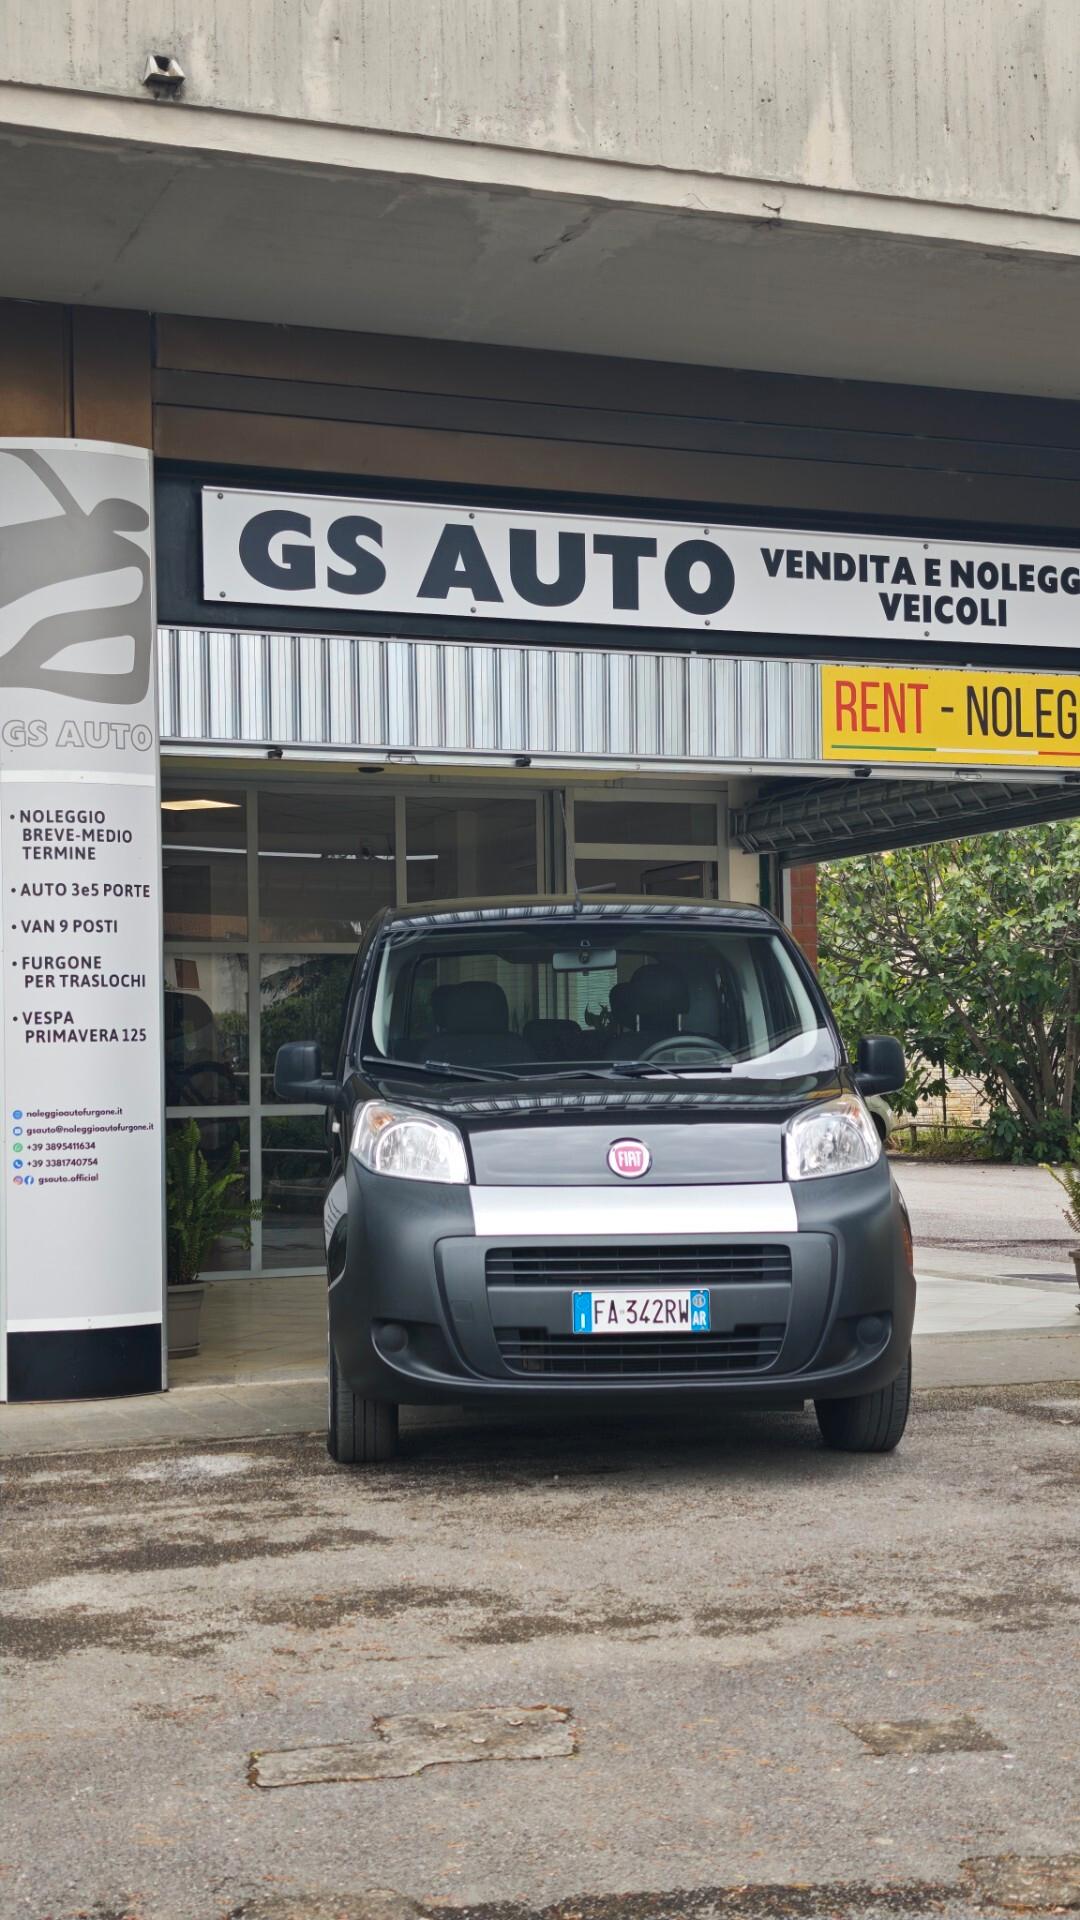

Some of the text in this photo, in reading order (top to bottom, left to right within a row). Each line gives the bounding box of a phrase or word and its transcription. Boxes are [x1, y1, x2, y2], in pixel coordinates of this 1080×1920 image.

[238, 509, 735, 615] GS AUTO
[760, 547, 1080, 595] VENDITA E NOLEGG
[878, 592, 1007, 627] VEICOLI
[835, 680, 928, 734] RENT
[967, 686, 1077, 740] NOLEG
[2, 719, 153, 752] GS AUTO
[20, 809, 106, 824] NOLEGGIO
[22, 828, 133, 844] BREVE-MEDIO
[22, 846, 96, 860] TERMINE
[20, 883, 151, 898] AUTO 3e5 PORTE
[21, 919, 118, 933] VAN 9 POSTI
[22, 956, 102, 970] FURGONE
[24, 974, 146, 988] PER TRASLOCHI
[22, 1011, 74, 1025] VESPA
[25, 1028, 147, 1043] PRIMAVERA 125
[26, 1107, 123, 1119] noleggioautofurgone.it
[26, 1122, 154, 1136] gsauto@noleggioautofurgone.it
[26, 1141, 96, 1152] +39 3895411634
[26, 1158, 98, 1168] +39 3381740754
[617, 1150, 642, 1167] FIAT
[38, 1173, 99, 1185] gsauto.official
[594, 1299, 618, 1324] FA
[626, 1299, 689, 1324] 342RW
[692, 1311, 707, 1326] AR
